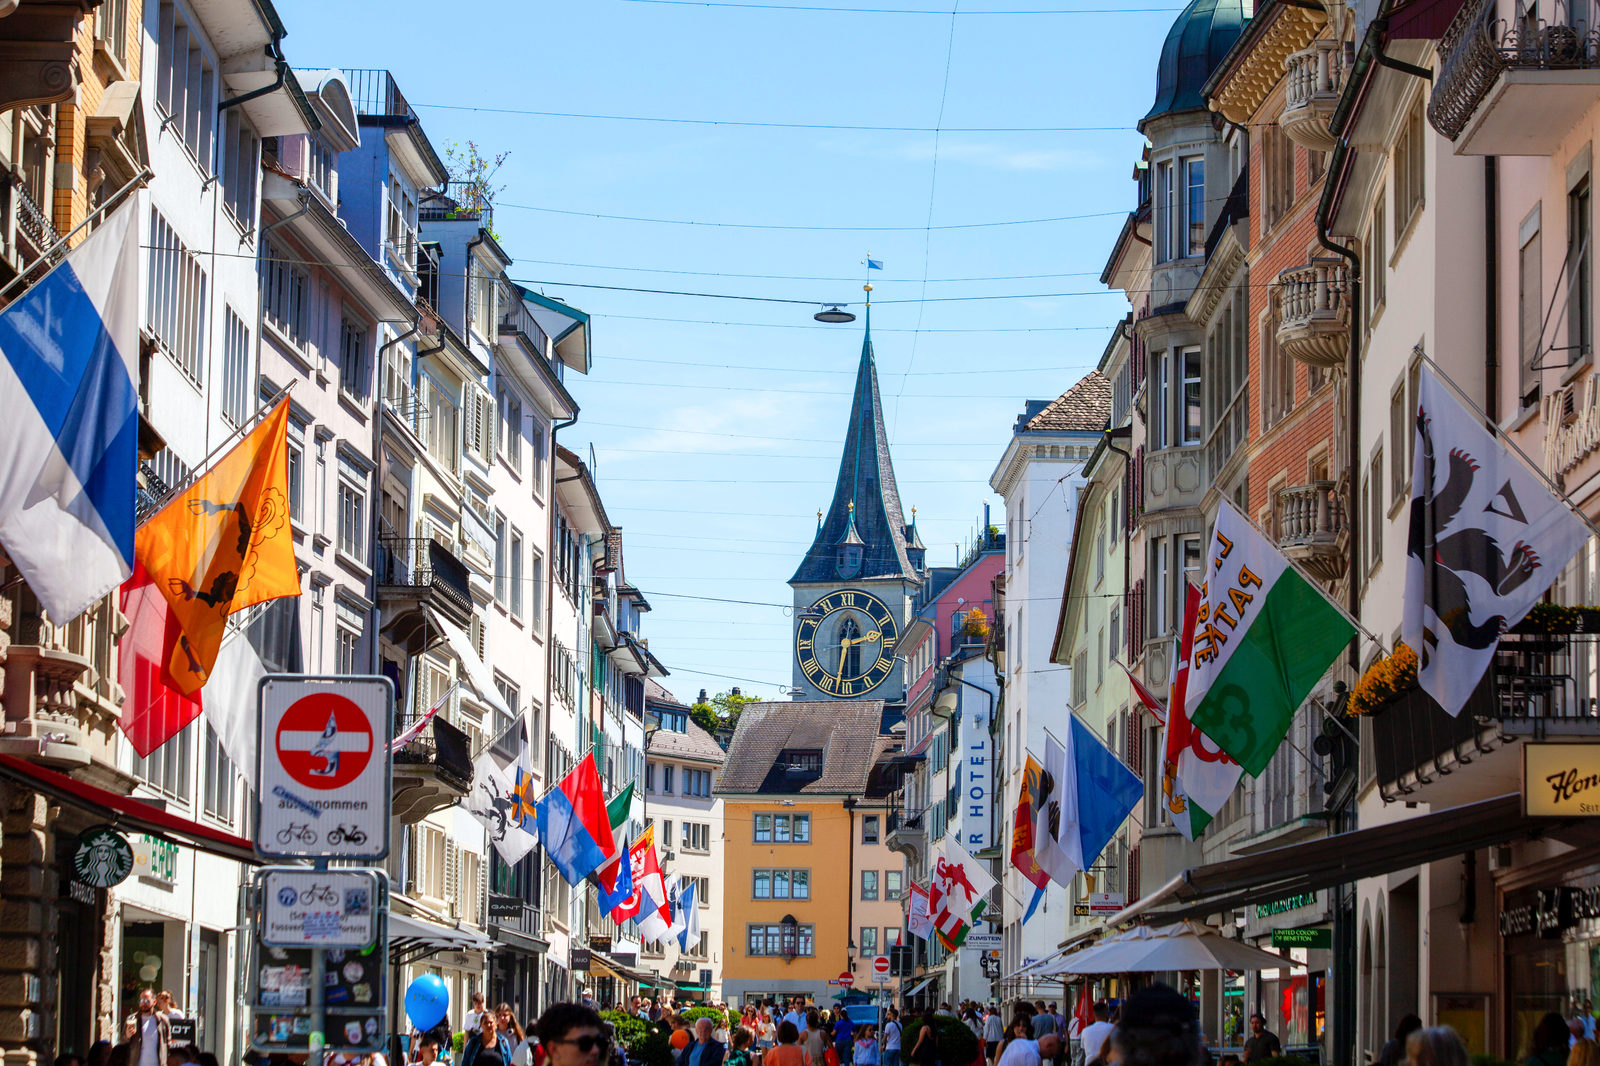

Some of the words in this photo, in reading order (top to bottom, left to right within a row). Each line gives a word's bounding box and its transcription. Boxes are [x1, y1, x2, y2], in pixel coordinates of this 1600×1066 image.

[820, 599, 834, 613] XI
[841, 594, 855, 606] XII
[866, 599, 873, 611] I
[878, 615, 890, 626] II
[970, 741, 985, 817] HOTEL
[1546, 768, 1600, 804] Hon
[1075, 906, 1089, 915] Sch
